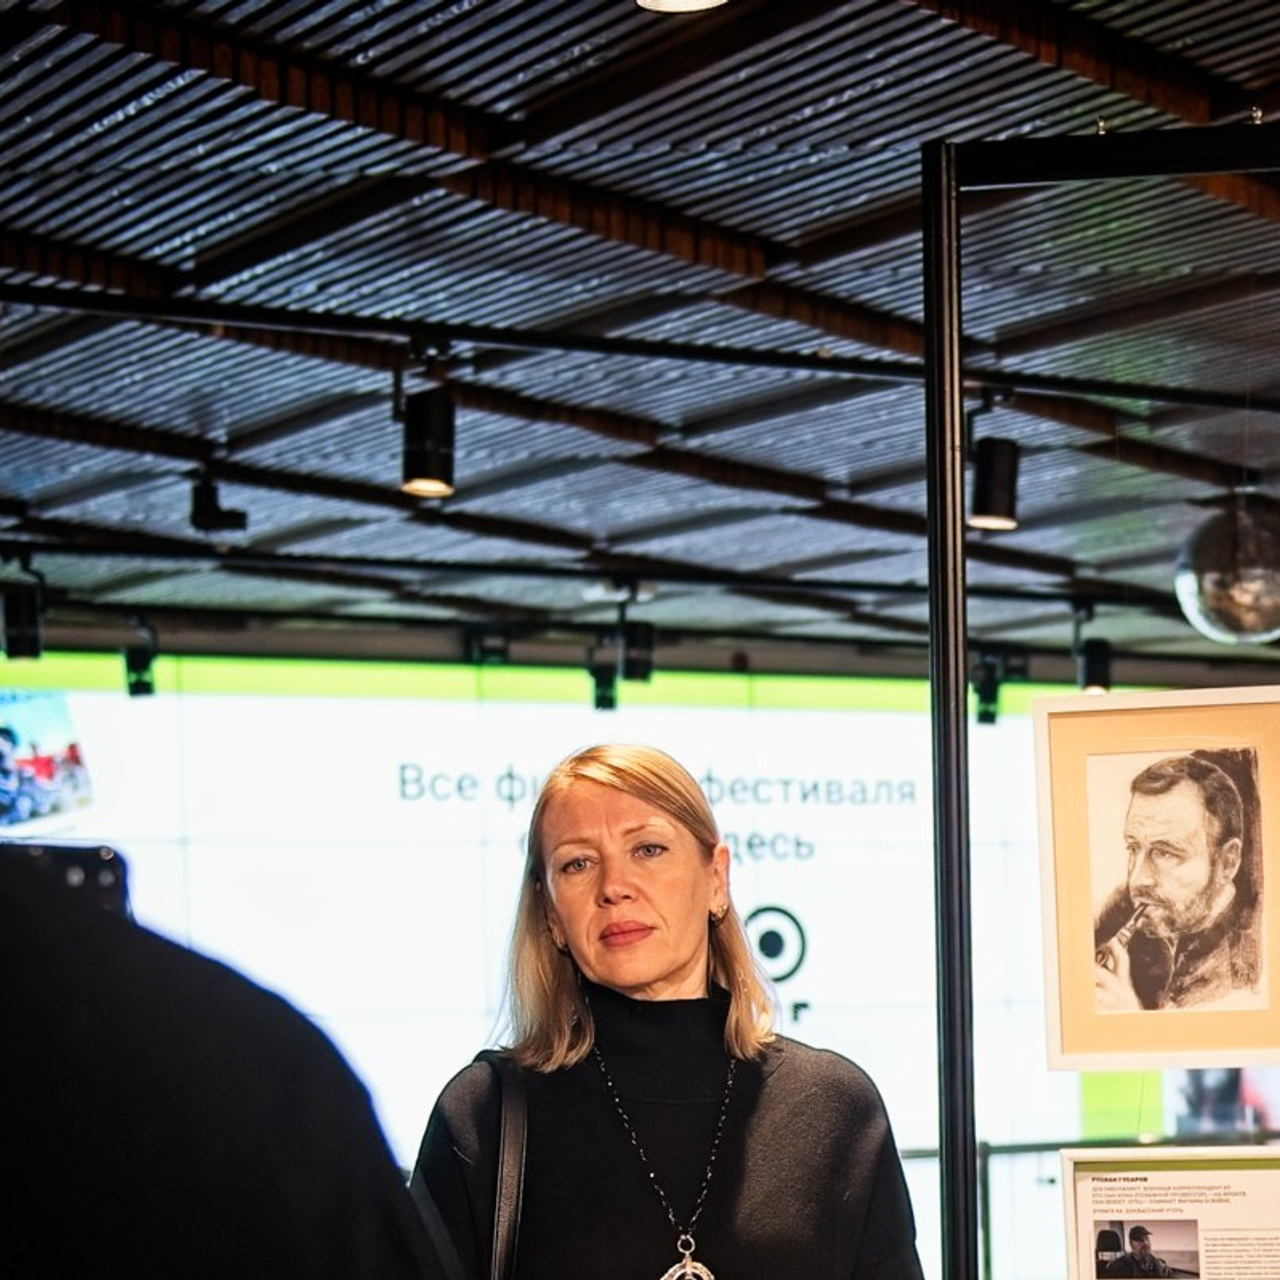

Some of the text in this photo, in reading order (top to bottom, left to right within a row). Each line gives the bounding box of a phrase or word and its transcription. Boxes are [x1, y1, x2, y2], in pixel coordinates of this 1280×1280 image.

[399, 764, 478, 801] Все
[700, 767, 916, 806] фестиваля
[722, 831, 816, 867] десь
